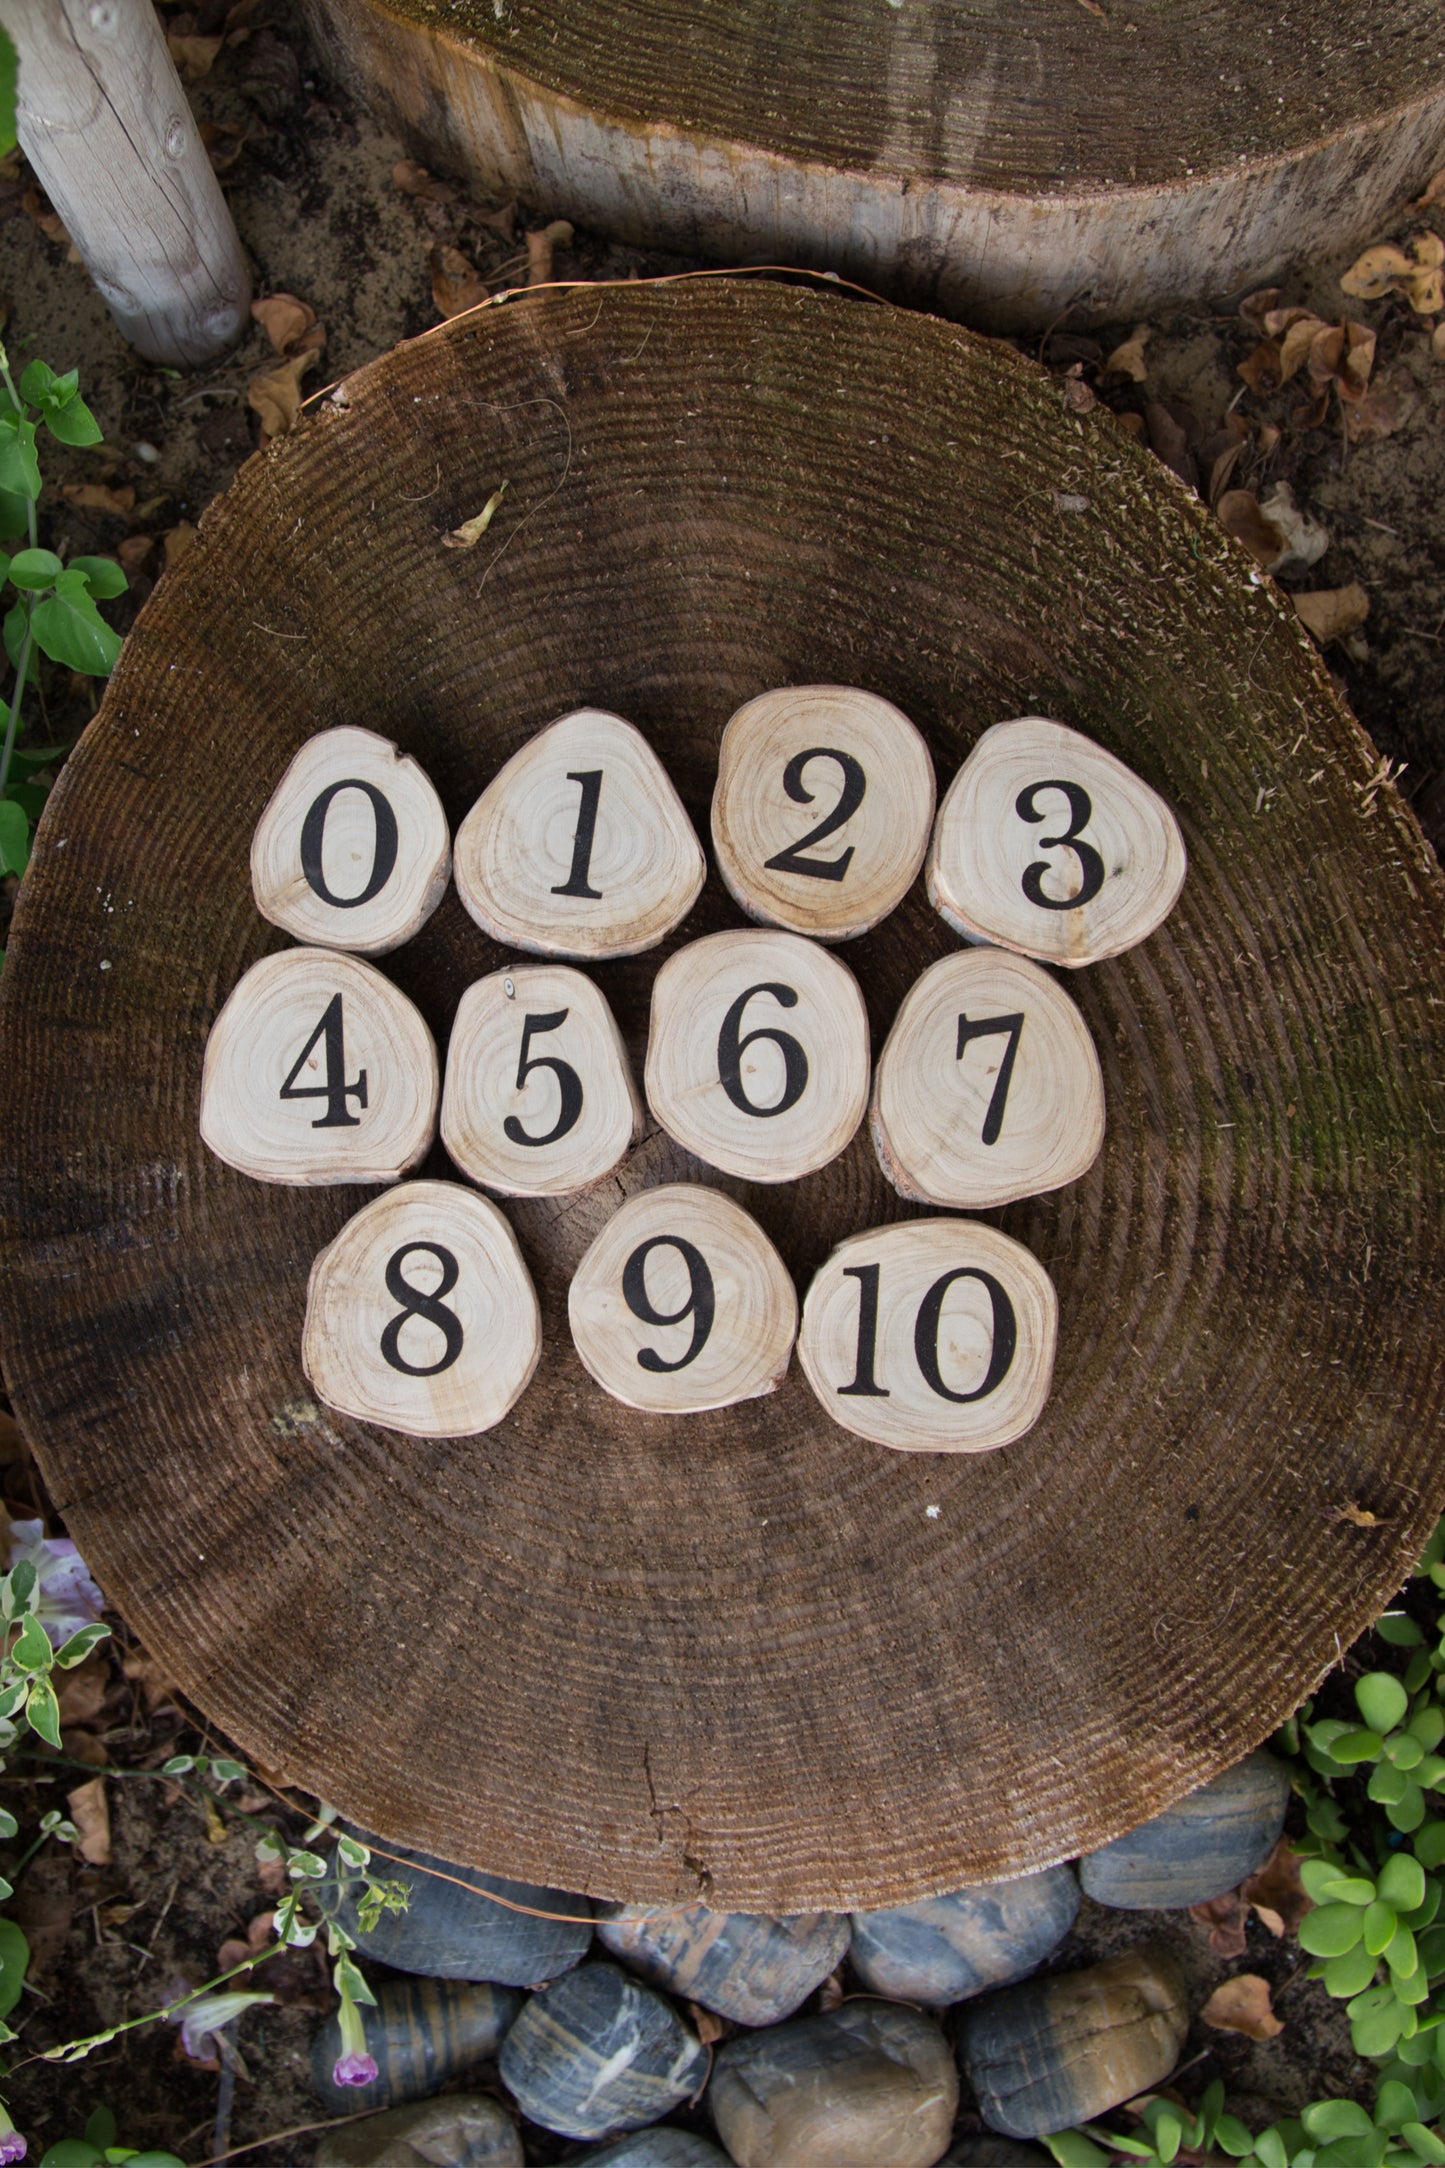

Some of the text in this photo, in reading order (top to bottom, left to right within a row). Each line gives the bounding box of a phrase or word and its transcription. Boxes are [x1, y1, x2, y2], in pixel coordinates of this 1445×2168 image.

[301, 778, 399, 908] 0
[550, 769, 603, 899] 1
[764, 748, 867, 881] 2
[1015, 779, 1105, 910] 3
[279, 992, 368, 1127] 4
[503, 1008, 584, 1146] 5
[717, 982, 809, 1117] 6
[956, 1012, 1025, 1146] 7
[380, 1241, 464, 1376] 8
[622, 1235, 715, 1372] 9
[837, 1262, 1017, 1403] 10
